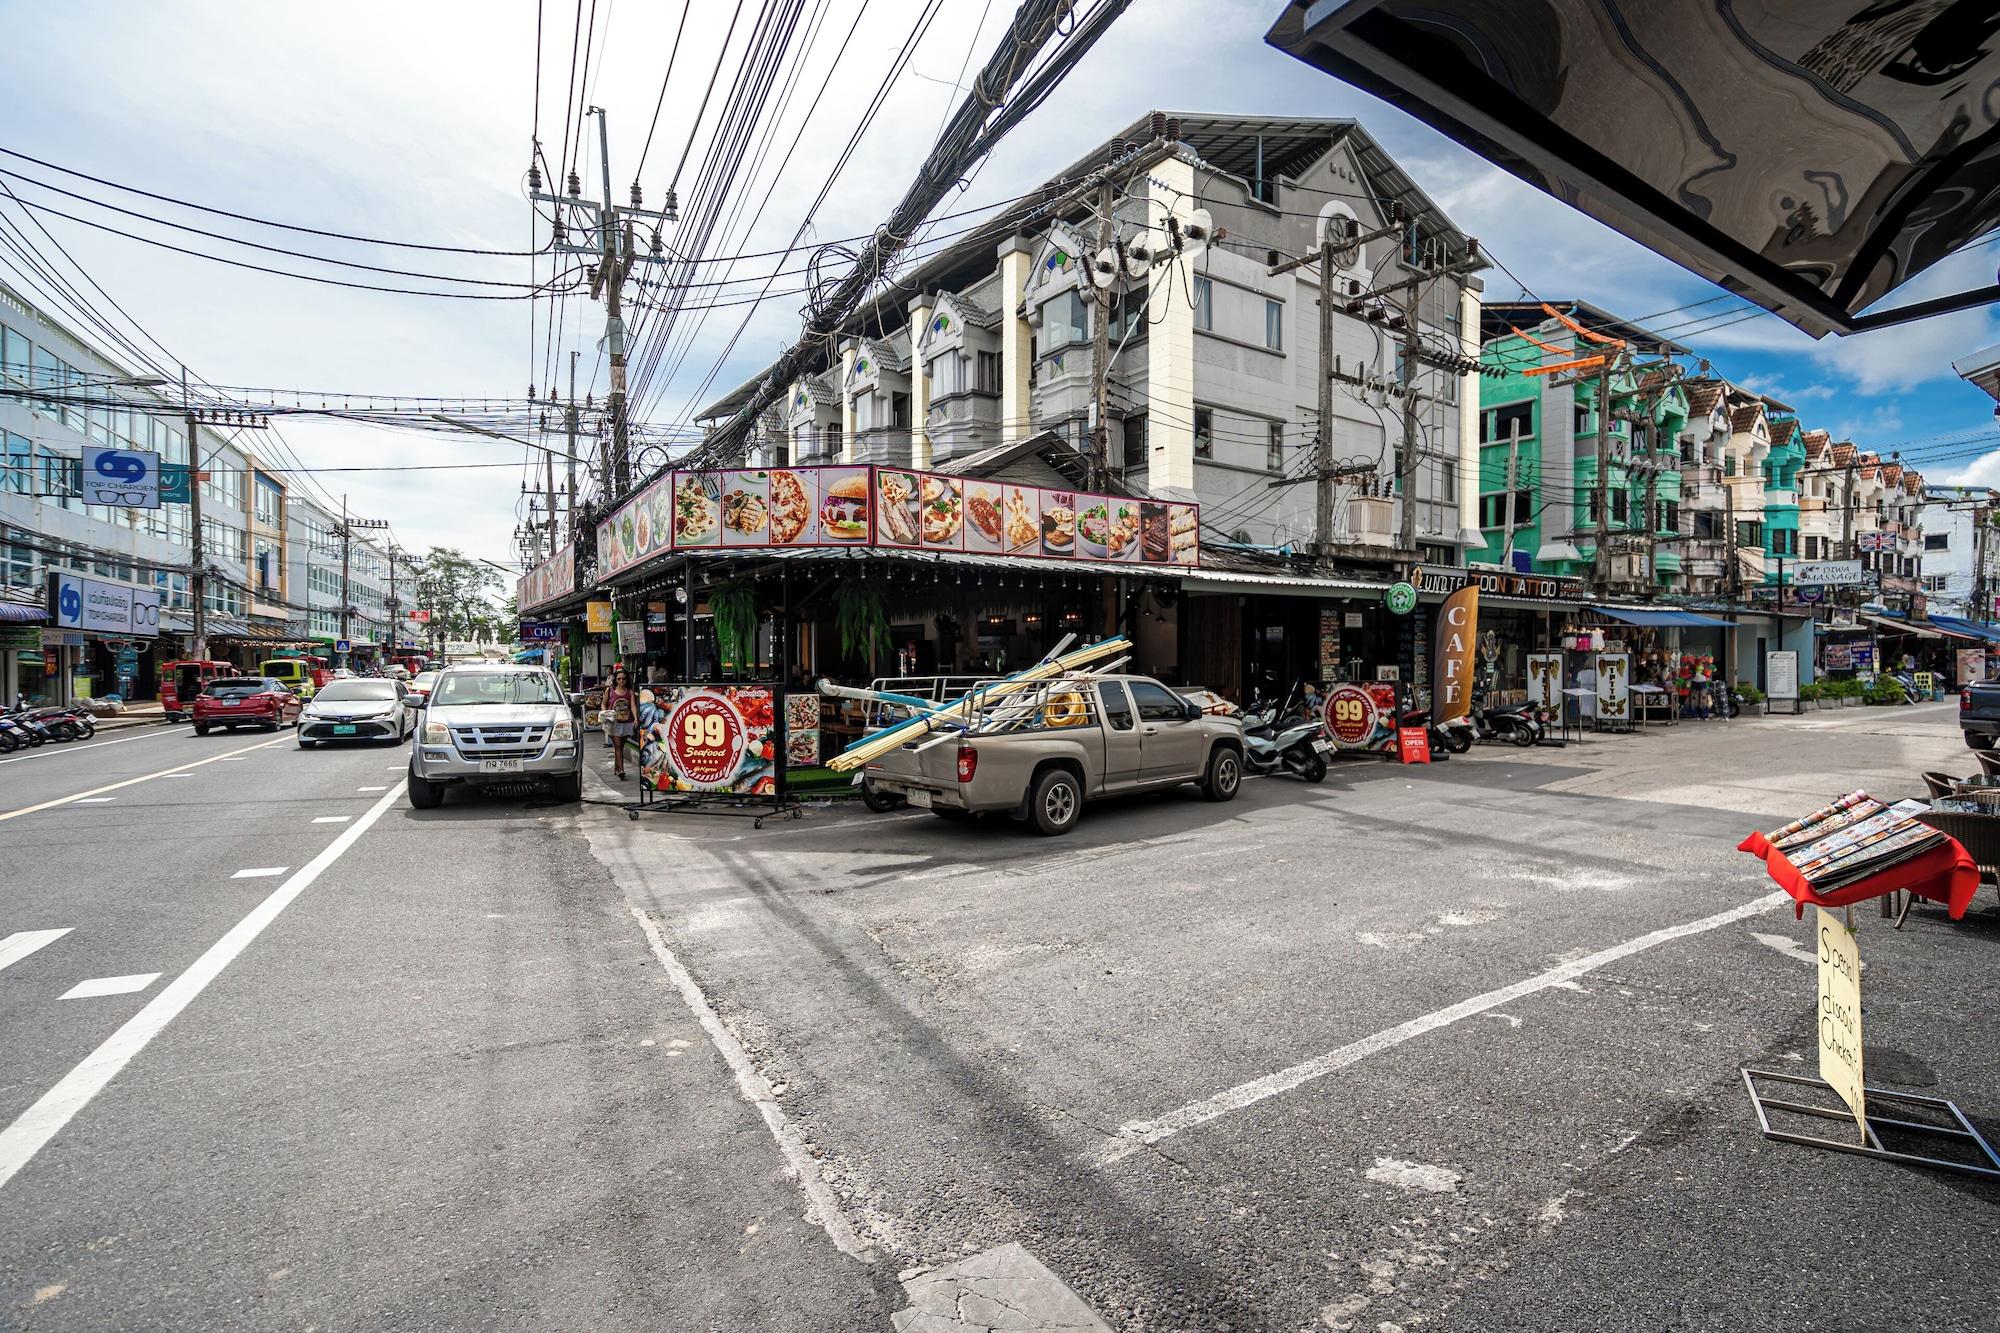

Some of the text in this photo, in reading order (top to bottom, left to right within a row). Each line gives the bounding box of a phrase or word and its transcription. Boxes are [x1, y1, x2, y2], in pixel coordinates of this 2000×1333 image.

[107, 483, 157, 492] CHAROEN
[1807, 572, 1858, 583] MASSAGE
[1471, 573, 1557, 597] TOON TATTOO
[1559, 591, 1583, 599] STUDIO
[522, 627, 560, 638] EXCHA
[1445, 606, 1467, 704] CAFÉ
[1335, 700, 1363, 721] 99
[1336, 720, 1364, 728] Seafood
[685, 714, 725, 747] 99
[684, 747, 726, 758] Seafood
[499, 760, 518, 768] 7665
[1821, 927, 1855, 984] Special
